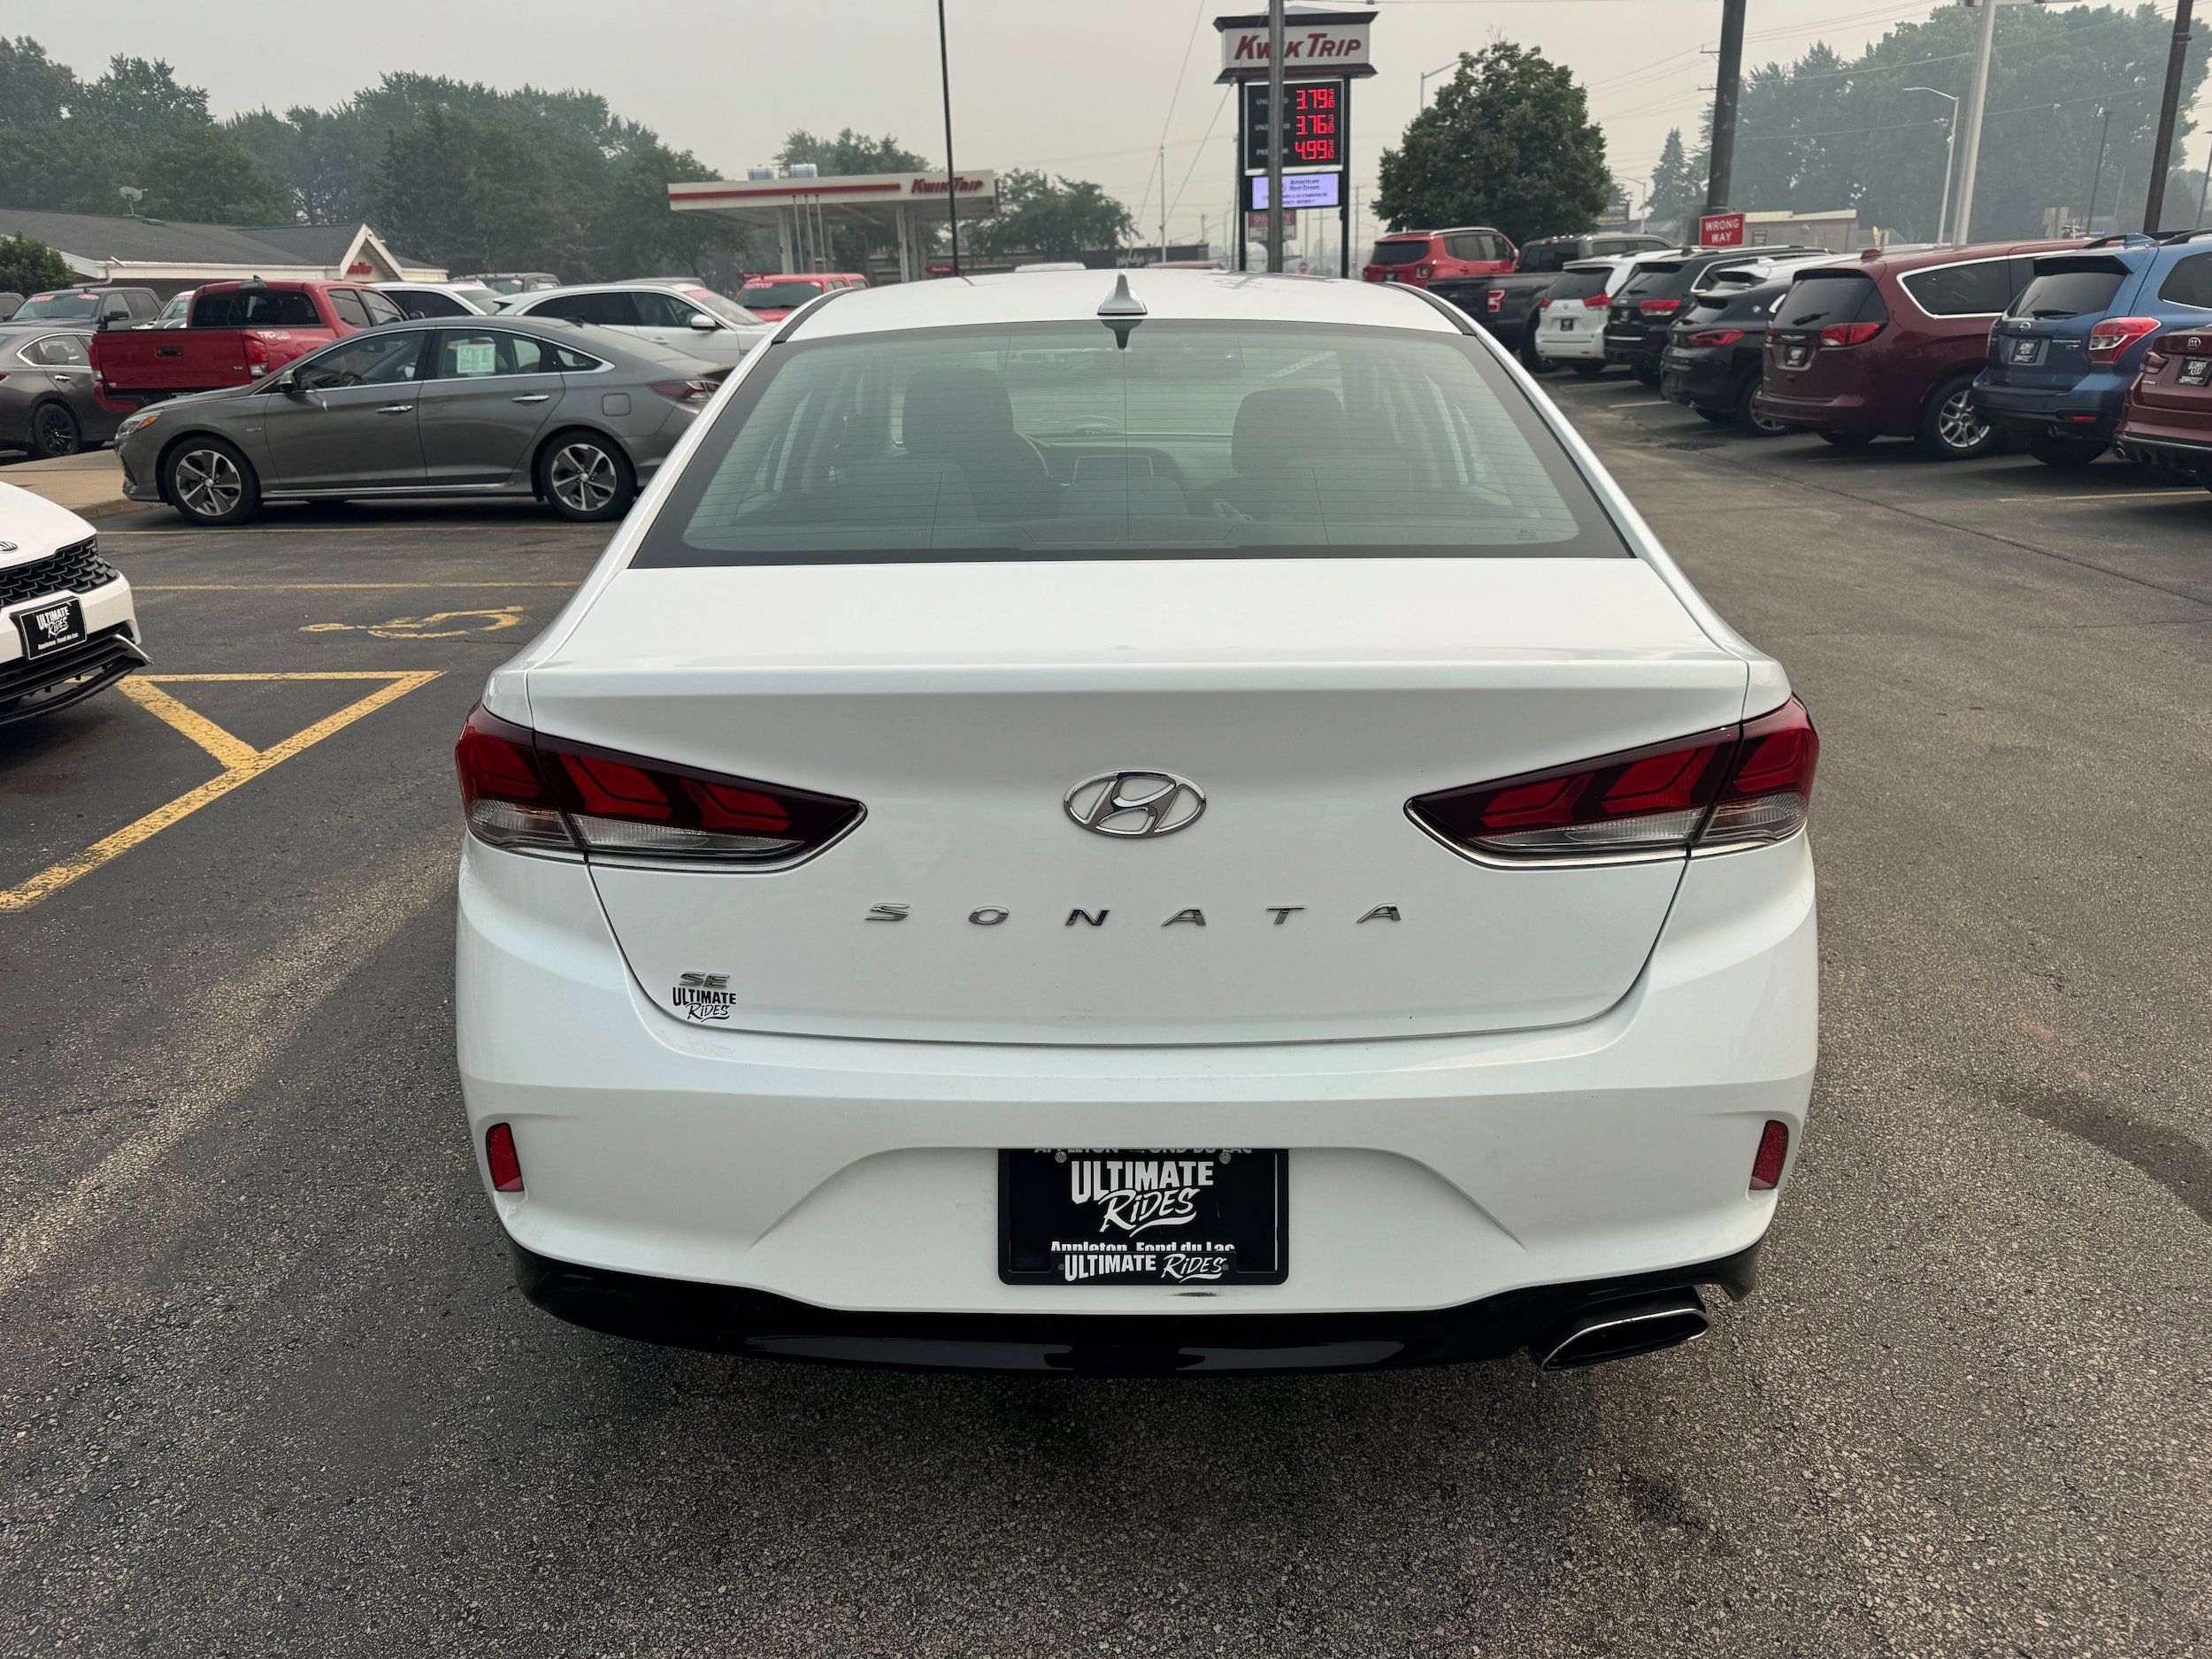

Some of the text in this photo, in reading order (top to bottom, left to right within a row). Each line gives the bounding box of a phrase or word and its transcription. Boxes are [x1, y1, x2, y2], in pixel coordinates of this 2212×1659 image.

[1234, 33, 1362, 60] KWK TRIP
[1704, 218, 1740, 231] WRONG
[1710, 231, 1733, 243] WAY
[36, 606, 70, 631] ULTIMATE
[864, 902, 1402, 928] SONATA
[679, 972, 730, 988] SE
[672, 987, 736, 1006] ULTIMATE
[1071, 1161, 1215, 1204] ULTIMATE
[1064, 1254, 1157, 1282] ULTIMATE
